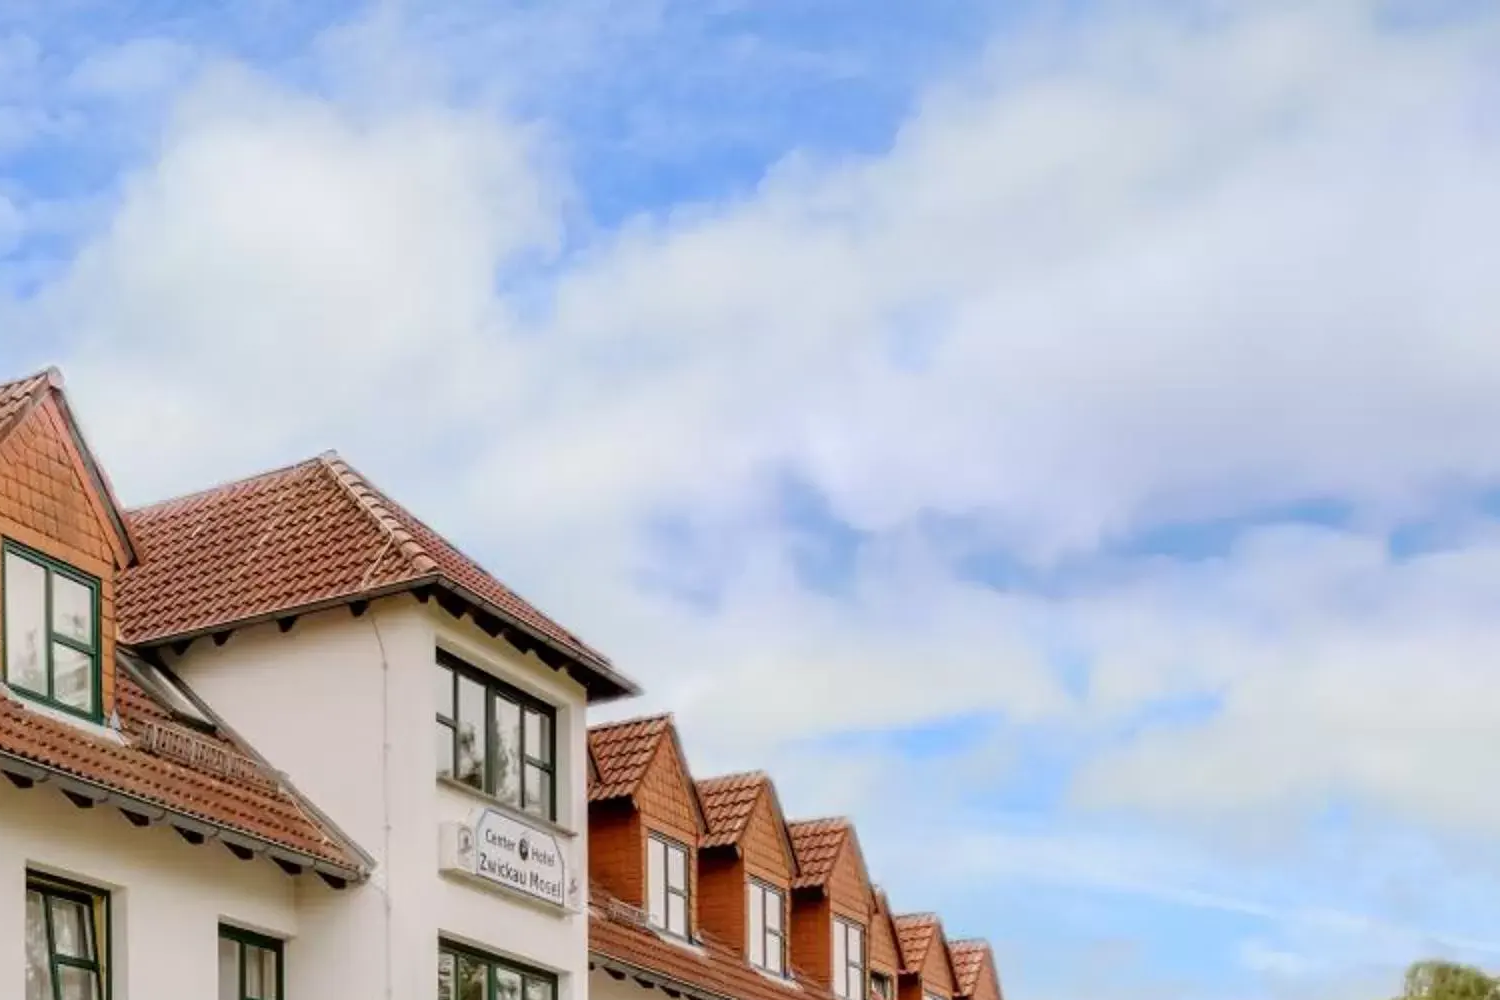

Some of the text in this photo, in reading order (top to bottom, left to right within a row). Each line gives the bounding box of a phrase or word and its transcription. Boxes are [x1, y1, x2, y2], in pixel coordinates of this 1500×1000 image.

[485, 828, 555, 868] Center Hotel
[479, 852, 561, 897] Zwickau Mosel
